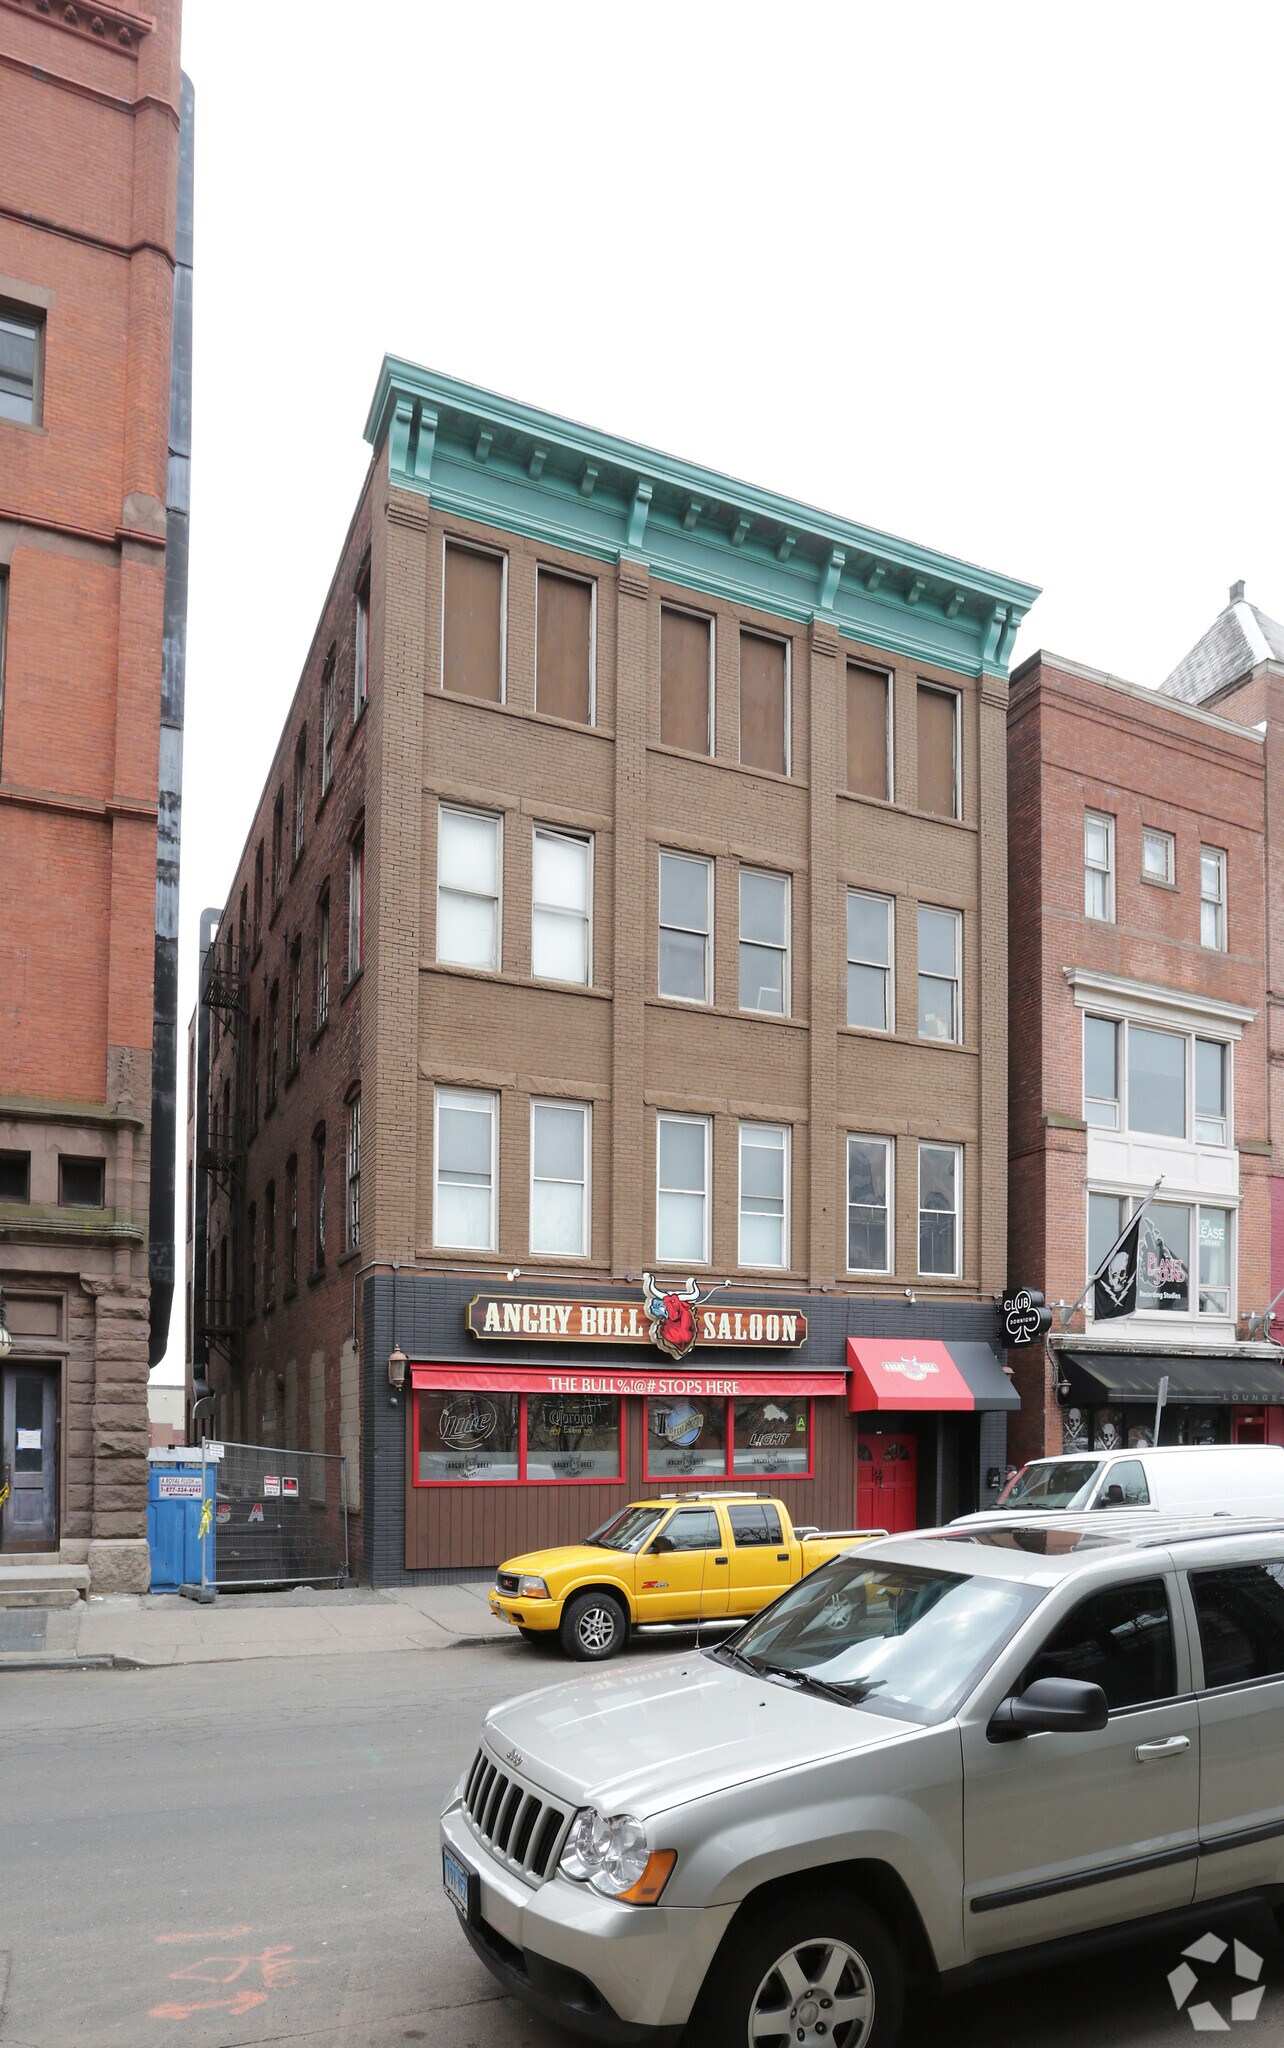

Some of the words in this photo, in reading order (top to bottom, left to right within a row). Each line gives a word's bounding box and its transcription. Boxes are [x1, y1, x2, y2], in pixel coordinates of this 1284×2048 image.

[1200, 1219, 1210, 1228] OR
[1147, 1252, 1184, 1270] PLANET
[1154, 1269, 1186, 1285] SOUND
[1139, 1291, 1163, 1300] Recording
[1163, 1291, 1181, 1300] Studios
[1003, 1297, 1029, 1311] CLUB
[483, 1302, 573, 1334] ANGRY
[579, 1306, 644, 1337] BULL
[703, 1312, 798, 1341] SALOON
[1010, 1316, 1036, 1325] DOWNTOWN
[548, 1377, 577, 1391] THE
[581, 1378, 656, 1393] BULL%!@#
[658, 1379, 702, 1394] STOPS
[706, 1380, 739, 1394] HERE
[549, 1409, 594, 1427] Corona
[797, 1417, 805, 1427] A
[749, 1433, 791, 1446] LIGHT
[247, 1503, 264, 1522] A
[506, 1748, 524, 1767] Jeep
